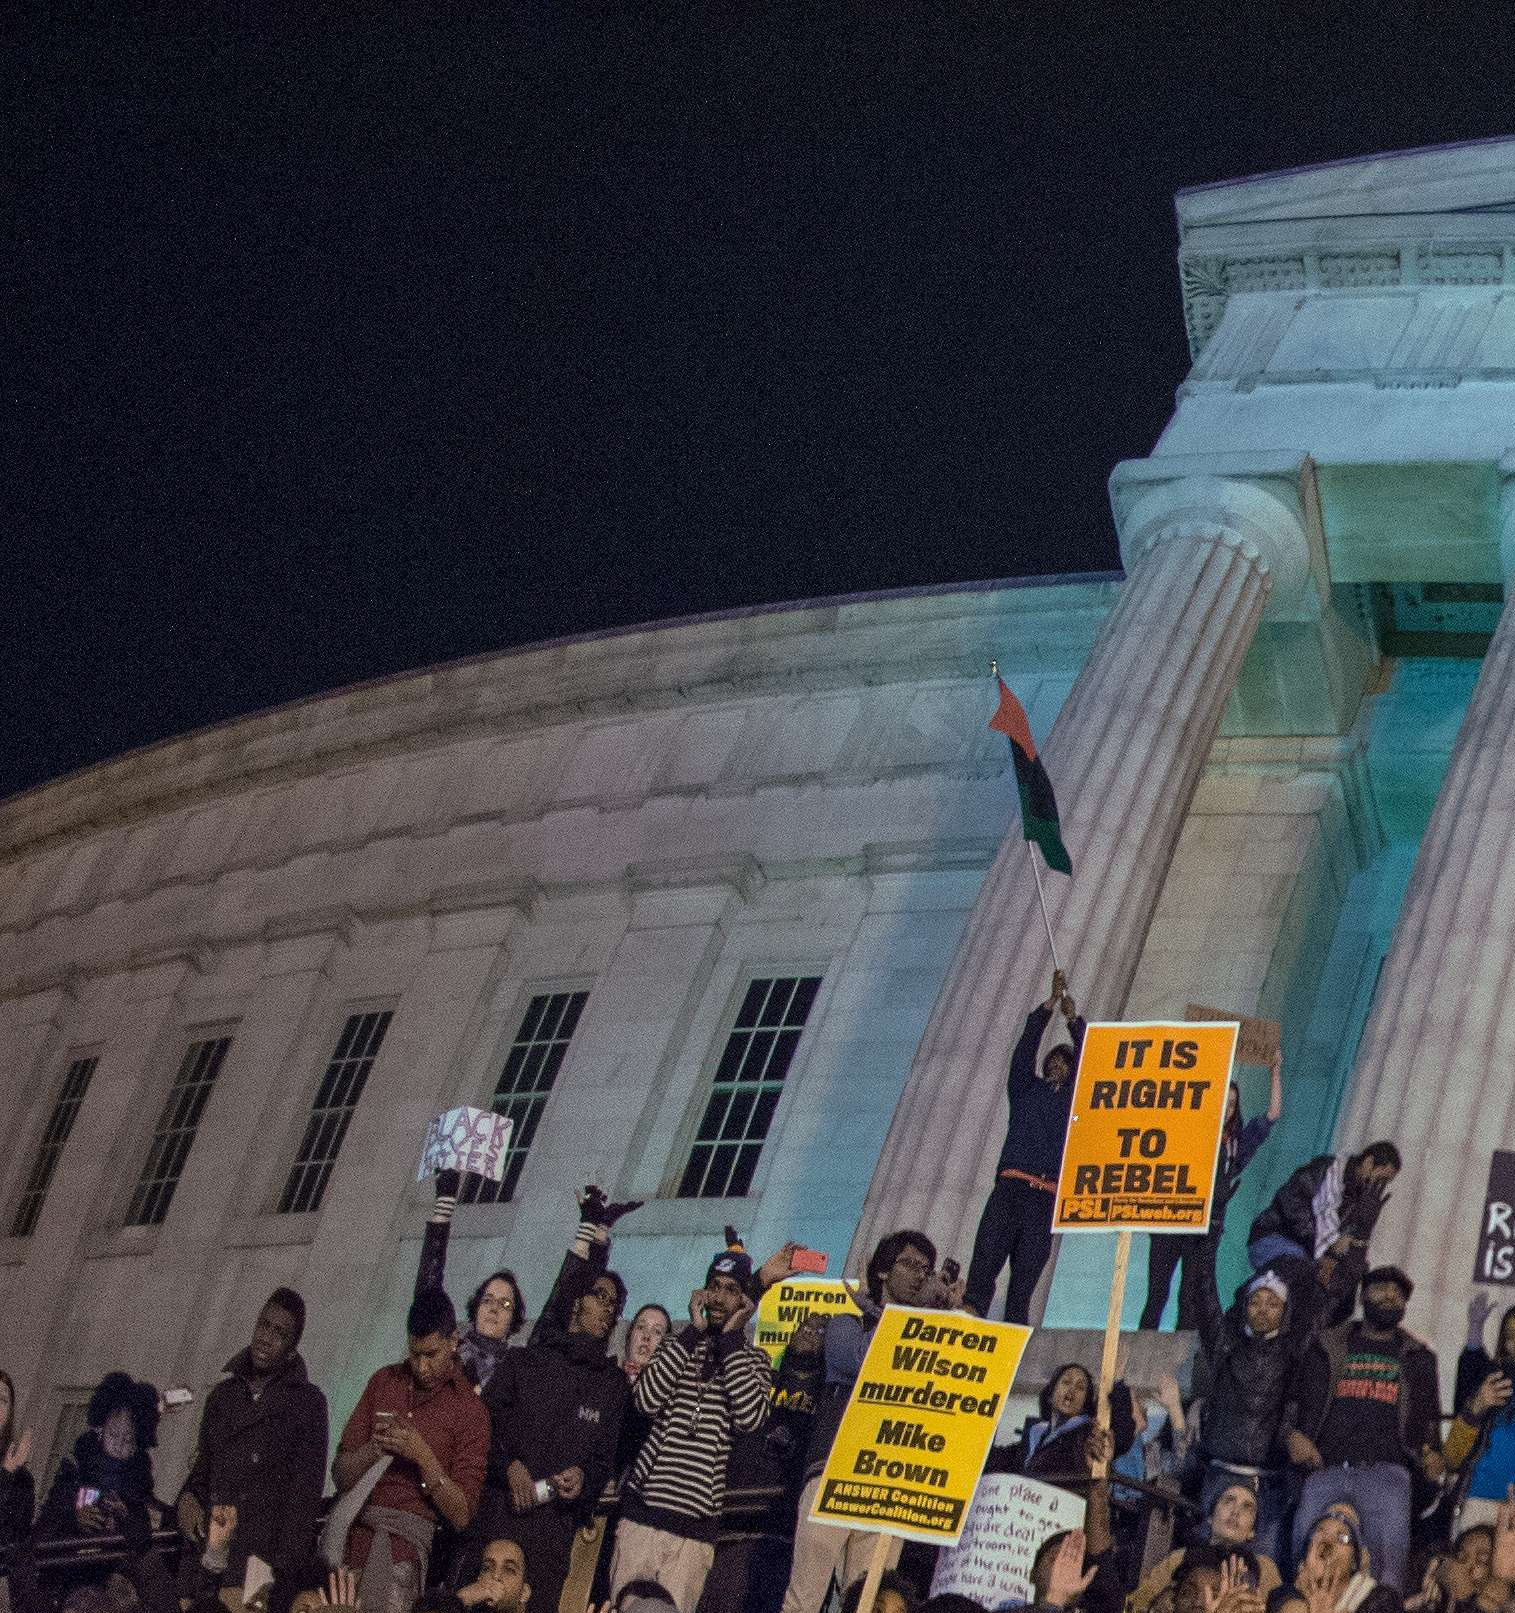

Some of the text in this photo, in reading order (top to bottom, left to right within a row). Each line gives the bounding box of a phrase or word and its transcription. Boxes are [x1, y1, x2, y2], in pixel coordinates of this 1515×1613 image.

[1115, 1039, 1198, 1069] IT IS
[1090, 1080, 1210, 1109] RIGHT
[1118, 1129, 1167, 1158] TO
[1074, 1164, 1197, 1195] REBEL
[1060, 1198, 1202, 1223] PSL PSLweb.org
[1484, 1241, 1514, 1279] IS
[780, 1286, 847, 1305] Darren
[900, 1317, 998, 1353] Darren
[891, 1345, 987, 1384] Wilson
[859, 1381, 1001, 1418] murdered
[875, 1419, 946, 1453] Mike
[853, 1449, 949, 1488] Brown
[825, 1497, 953, 1529] AnswerCoalition.org
[833, 1483, 955, 1513] ANSWER Coalition
